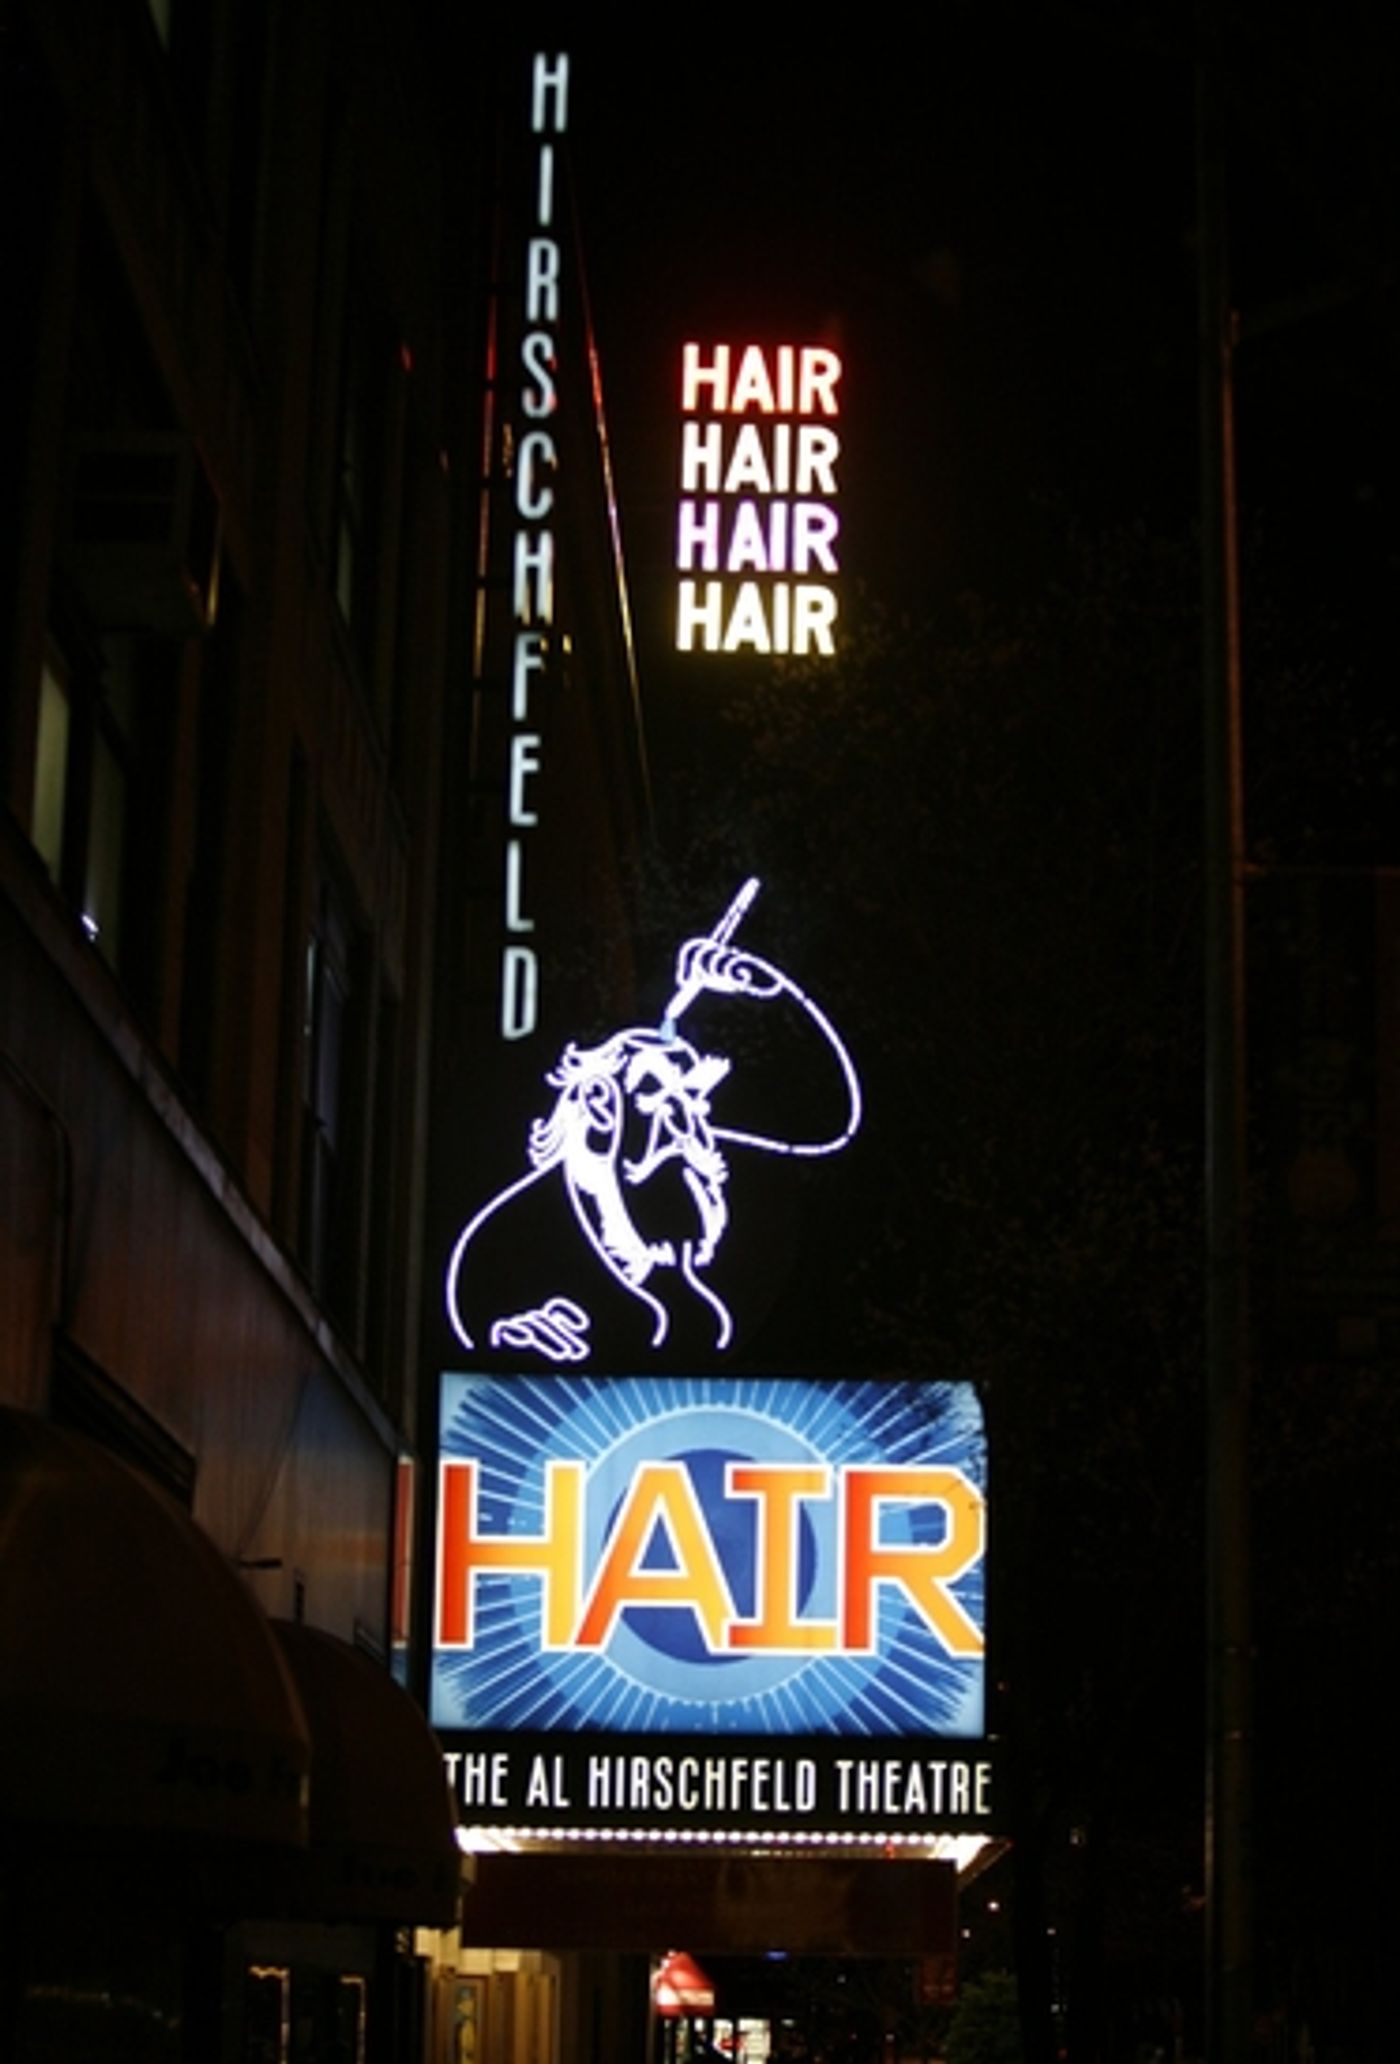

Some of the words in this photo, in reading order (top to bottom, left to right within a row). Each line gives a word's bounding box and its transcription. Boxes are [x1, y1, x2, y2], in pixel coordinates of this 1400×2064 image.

[682, 343, 842, 415] HAIR
[682, 421, 840, 494] HAIR
[502, 53, 569, 1040] HIRSCHFELD
[677, 500, 840, 573] HAIR
[676, 580, 838, 655] HAIR
[434, 1457, 988, 1658] HAIR
[442, 1752, 509, 1807] THE
[526, 1754, 571, 1808] AL
[588, 1755, 818, 1812] HIRSCHFELD
[835, 1759, 992, 1815] THEATRE
